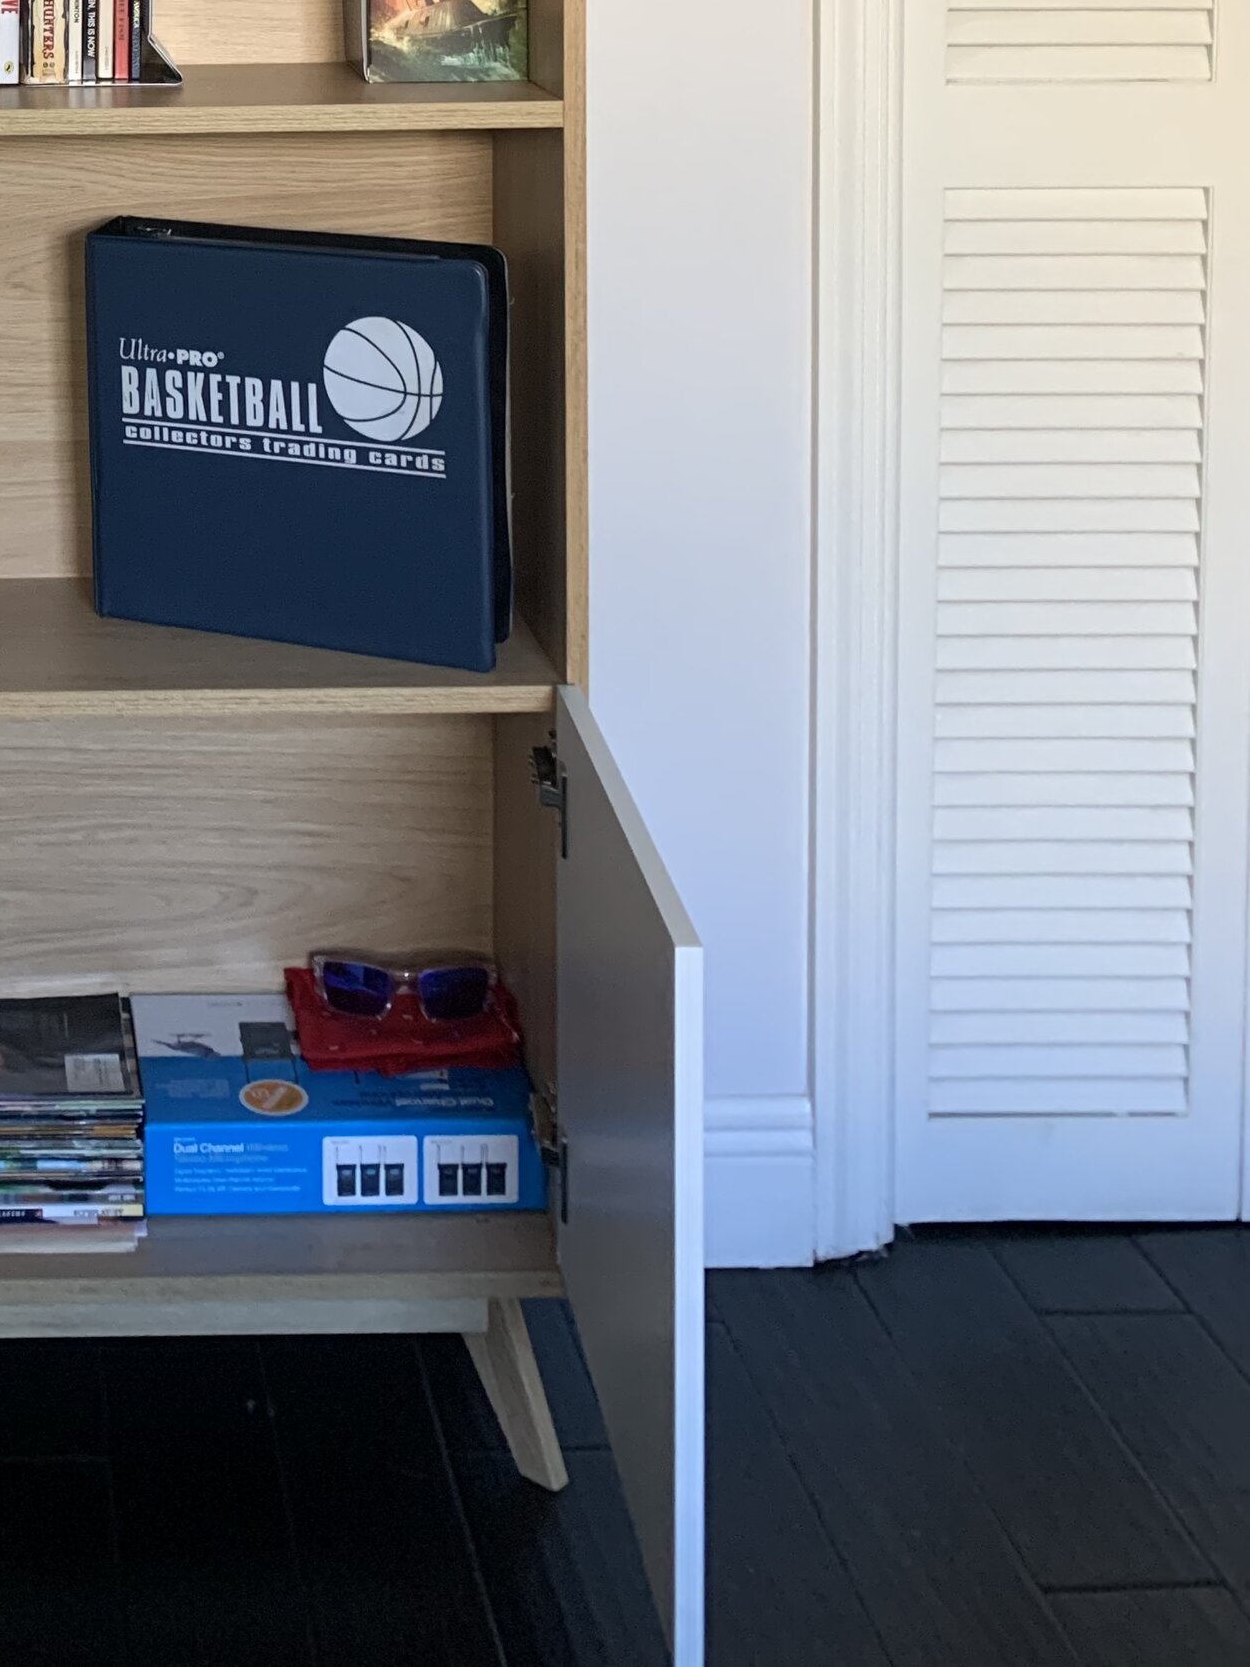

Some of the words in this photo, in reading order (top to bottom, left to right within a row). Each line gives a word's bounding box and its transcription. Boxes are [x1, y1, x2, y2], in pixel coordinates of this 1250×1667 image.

[87, 12, 96, 27] THIS
[87, 36, 95, 57] NOW
[121, 364, 323, 435] BASKETBALL
[125, 424, 252, 451] collectors
[263, 437, 357, 465] trading
[369, 450, 447, 473] cards
[173, 1142, 198, 1153] Dual
[199, 1142, 244, 1153] Channel
